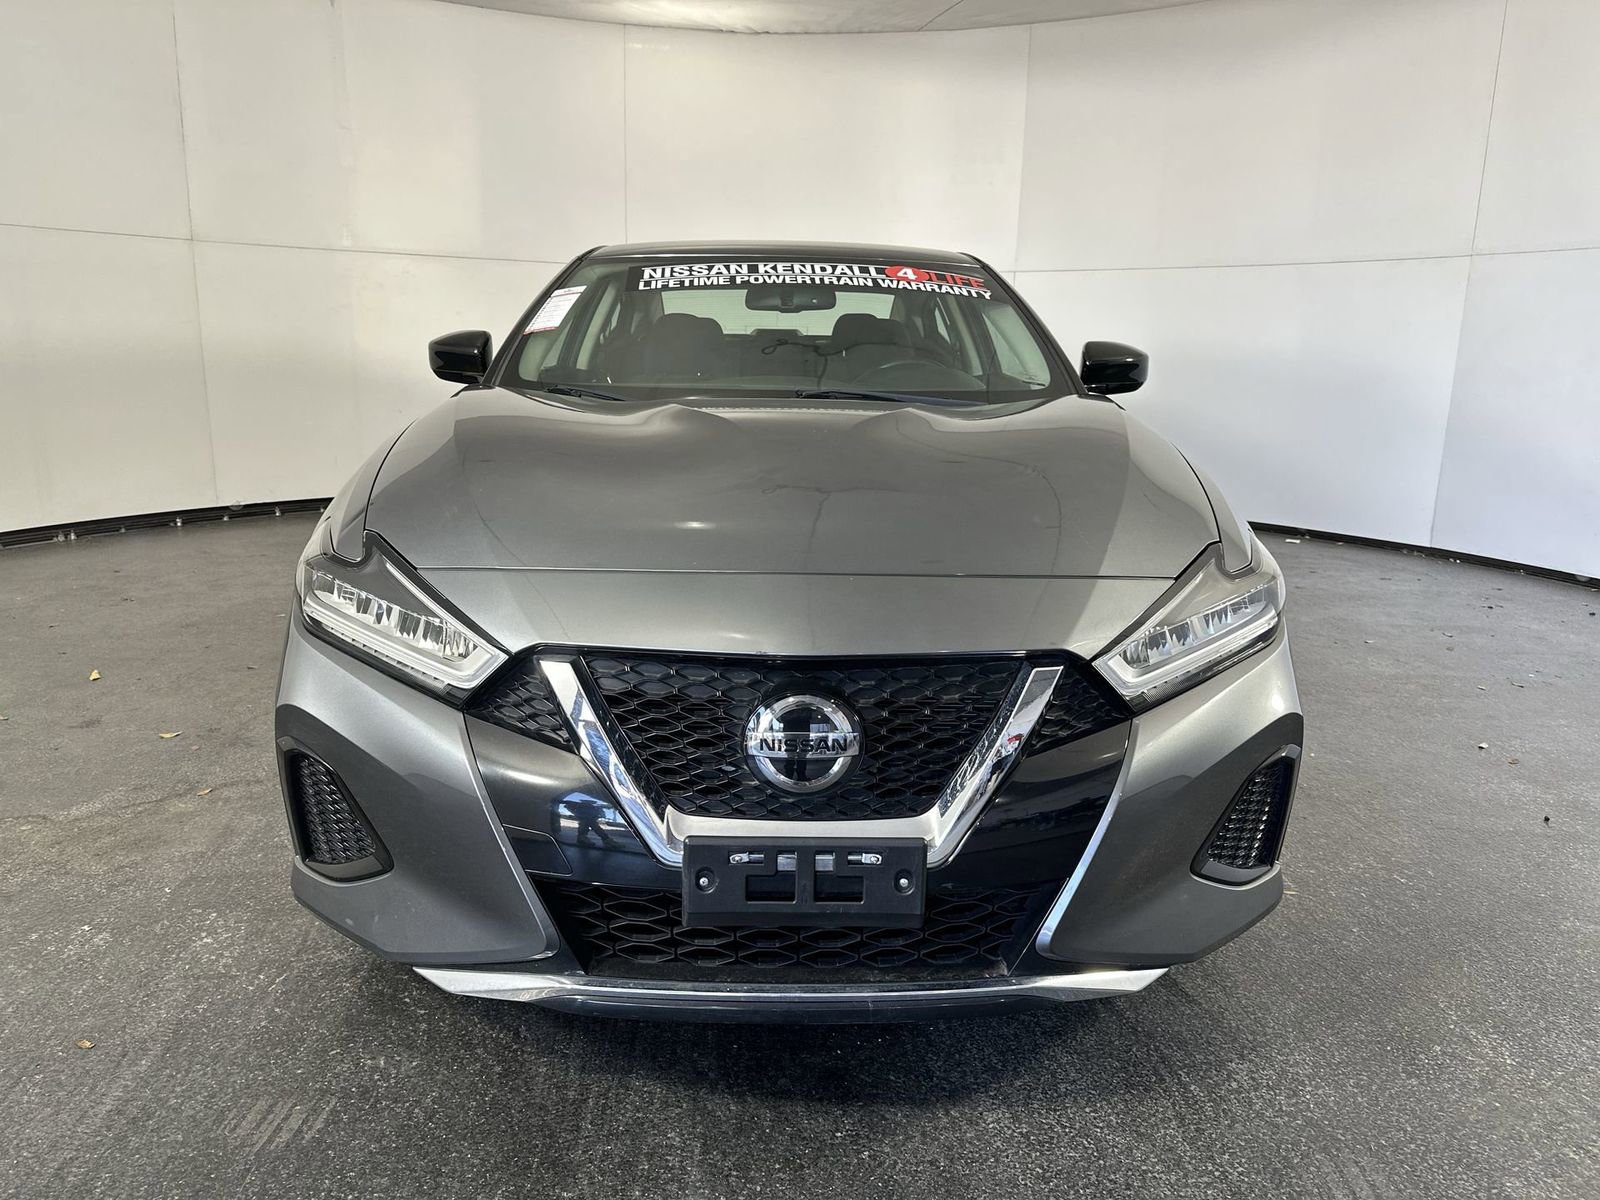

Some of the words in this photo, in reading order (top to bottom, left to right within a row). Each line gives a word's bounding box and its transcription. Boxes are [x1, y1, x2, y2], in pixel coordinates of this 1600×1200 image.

[638, 276, 731, 290] LIFETIME
[736, 275, 873, 287] POWERTRAIN
[877, 278, 992, 300] WARRANTY
[642, 264, 749, 280] NISSAN
[758, 263, 884, 278] KENDALL
[896, 267, 918, 280] 4
[929, 272, 985, 288] LIFE
[760, 738, 848, 752] NISSAN
